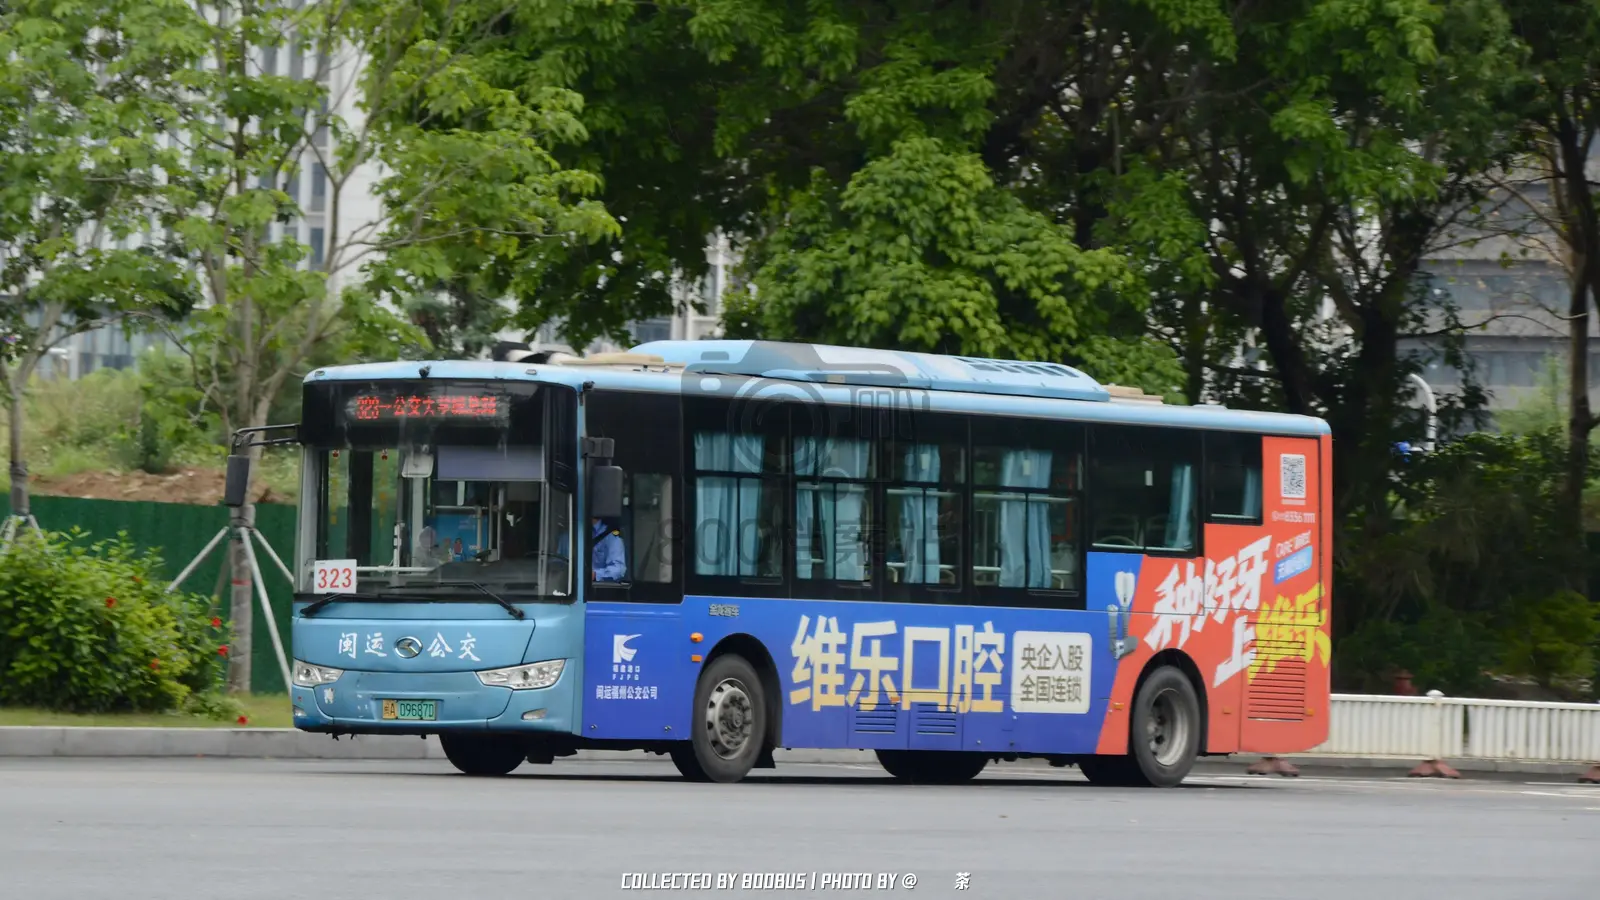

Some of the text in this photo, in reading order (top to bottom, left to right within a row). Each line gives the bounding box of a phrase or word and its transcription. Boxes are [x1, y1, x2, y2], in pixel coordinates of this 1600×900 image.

[318, 568, 352, 589] 323
[1144, 535, 1272, 651] 种好牙
[338, 632, 482, 662] 闽运 公交
[1021, 644, 1083, 672] 央企入股
[790, 614, 1005, 714] 维乐口腔
[1020, 675, 1082, 703] 全国连锁
